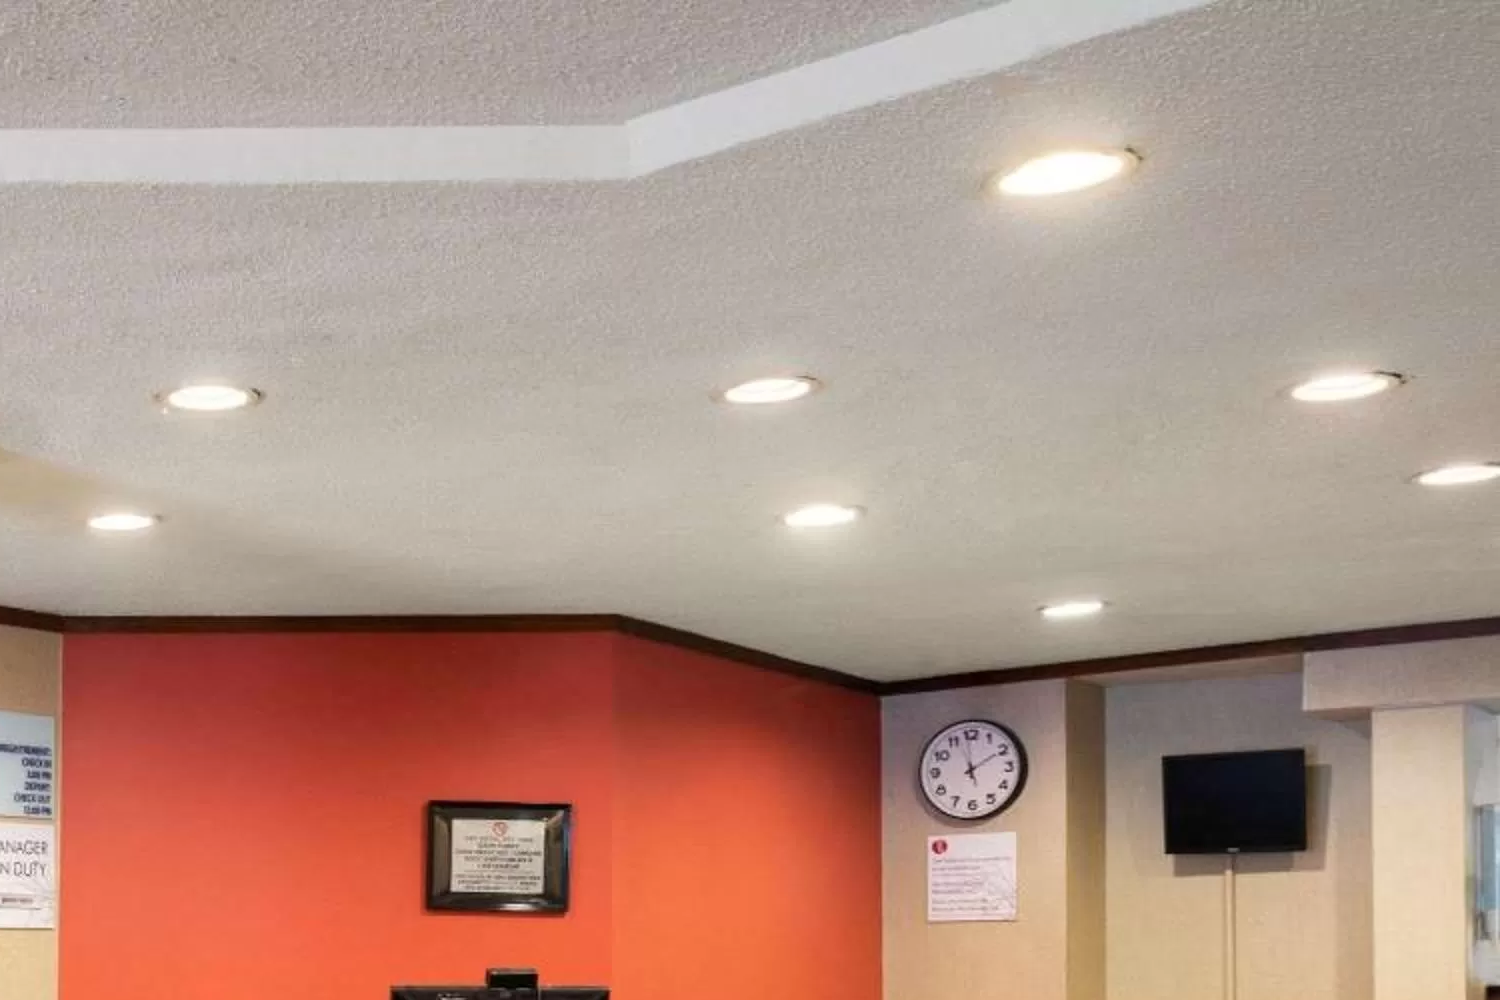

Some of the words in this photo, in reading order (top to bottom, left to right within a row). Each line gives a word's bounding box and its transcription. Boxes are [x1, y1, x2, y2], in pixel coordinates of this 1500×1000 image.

[964, 729, 979, 741] 12
[997, 743, 1009, 756] 2
[935, 750, 950, 762] 10
[1004, 761, 1015, 773] 3
[930, 768, 941, 779] 9
[936, 784, 946, 796] 8
[998, 779, 1009, 790] 4
[952, 796, 961, 808] 7
[967, 799, 978, 811] 6
[986, 793, 997, 805] 5
[13, 861, 47, 878] DUTY
